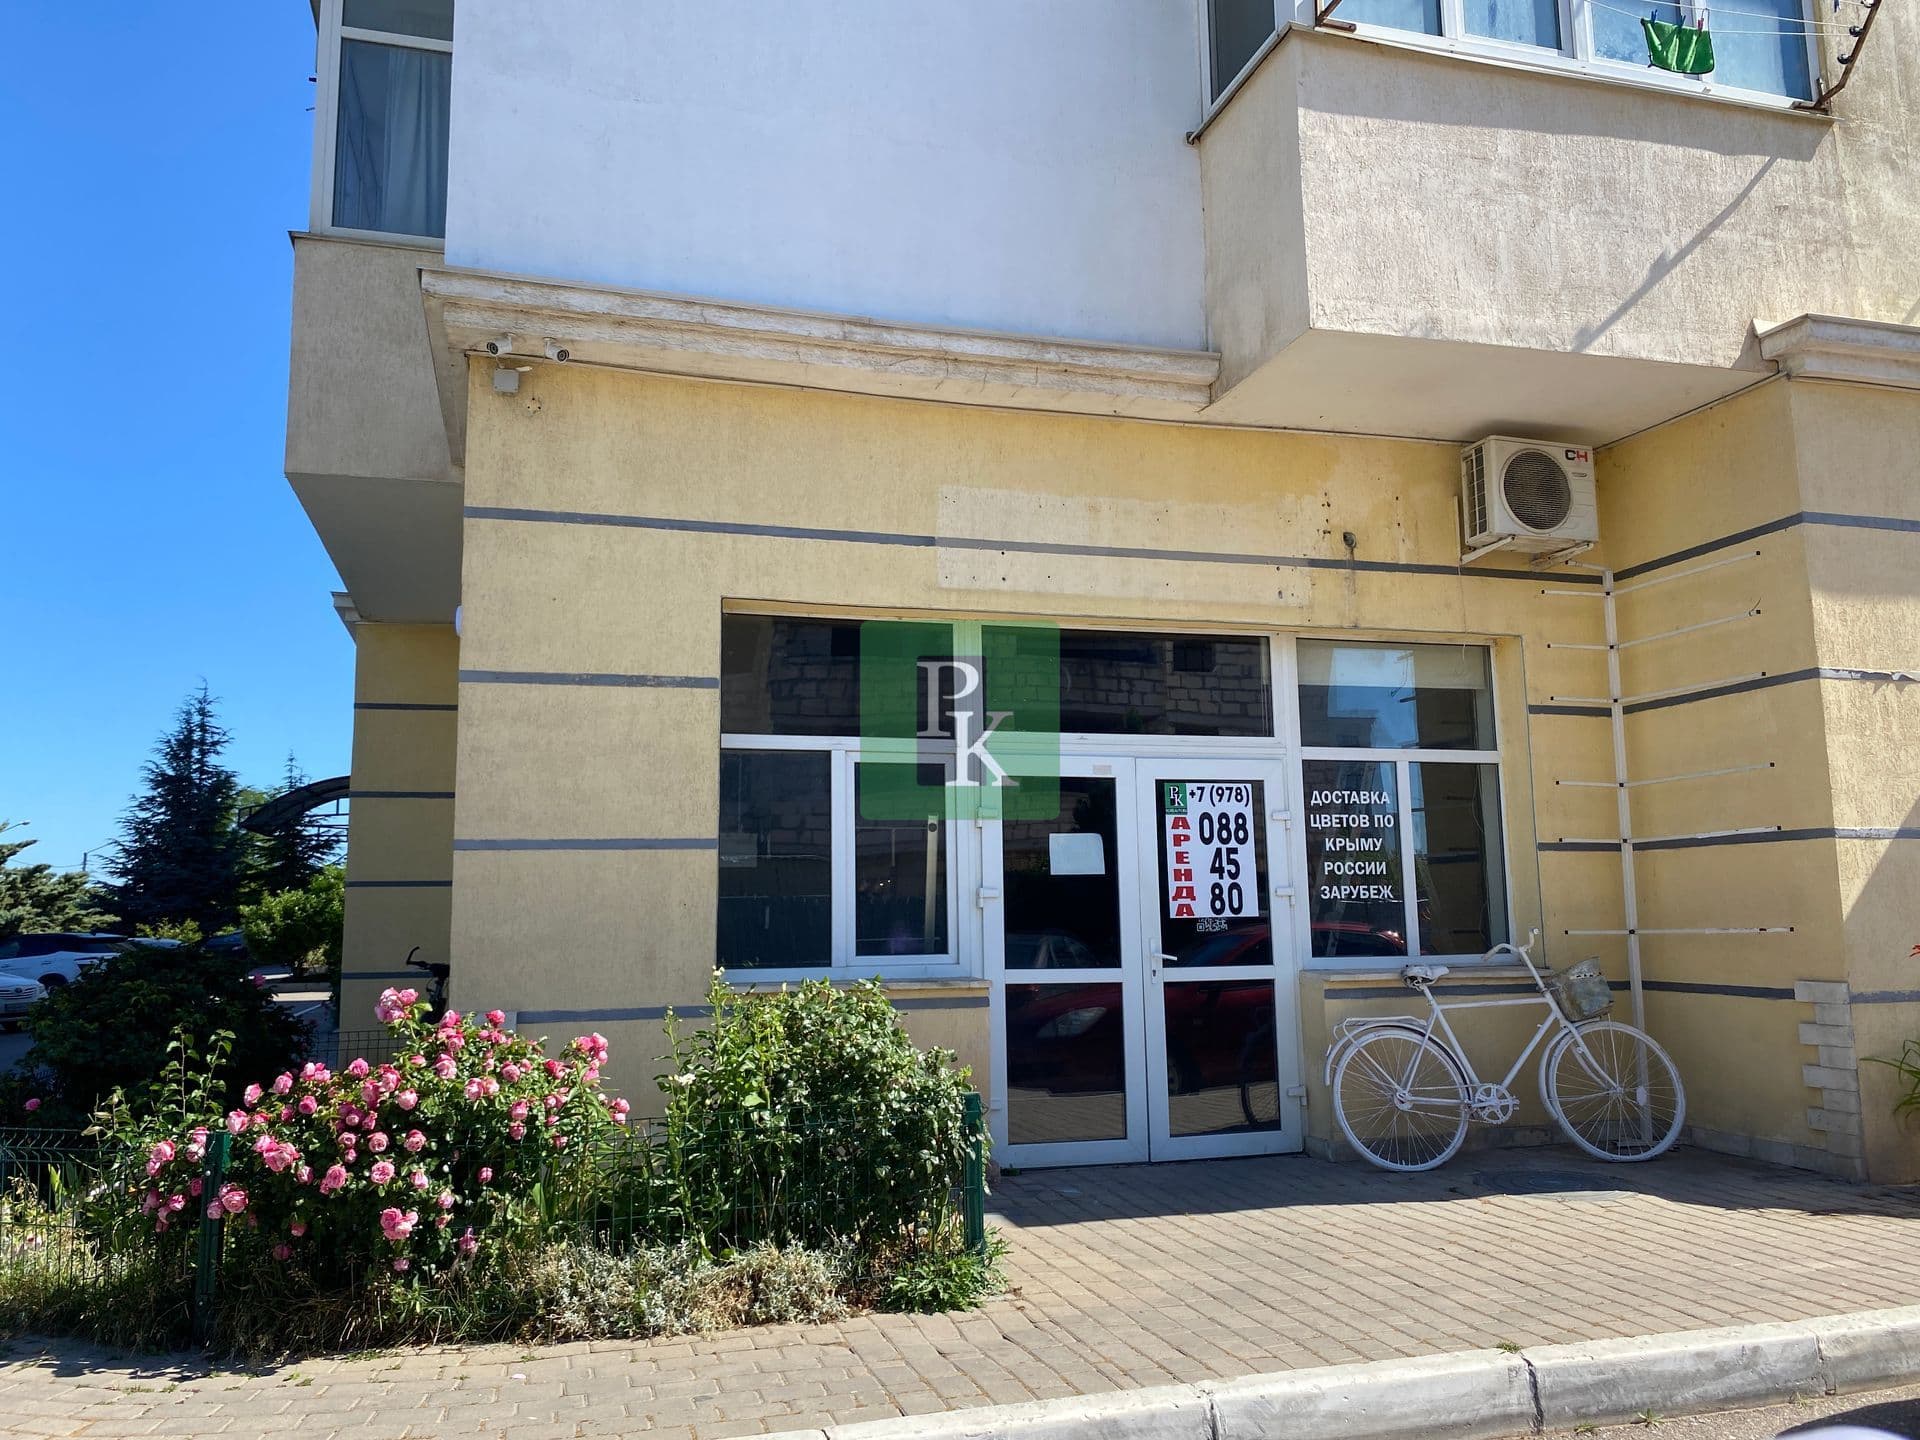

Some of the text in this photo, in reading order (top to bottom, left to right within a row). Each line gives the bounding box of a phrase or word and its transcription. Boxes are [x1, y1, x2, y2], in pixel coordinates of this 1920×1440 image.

[1188, 784, 1250, 807] +7 (978)
[1310, 790, 1390, 806] ДОСТАВКА
[1198, 811, 1249, 845] 088
[1310, 814, 1395, 830] ЦВЕТОВ ПО
[1325, 837, 1383, 852] КРЫМУ
[1171, 816, 1196, 917] АРЕНДА
[1209, 846, 1241, 880] 45
[1324, 861, 1387, 875] РОССИИ
[1210, 881, 1243, 916] 80
[1320, 885, 1394, 899] ЗАРУБЕЖ
